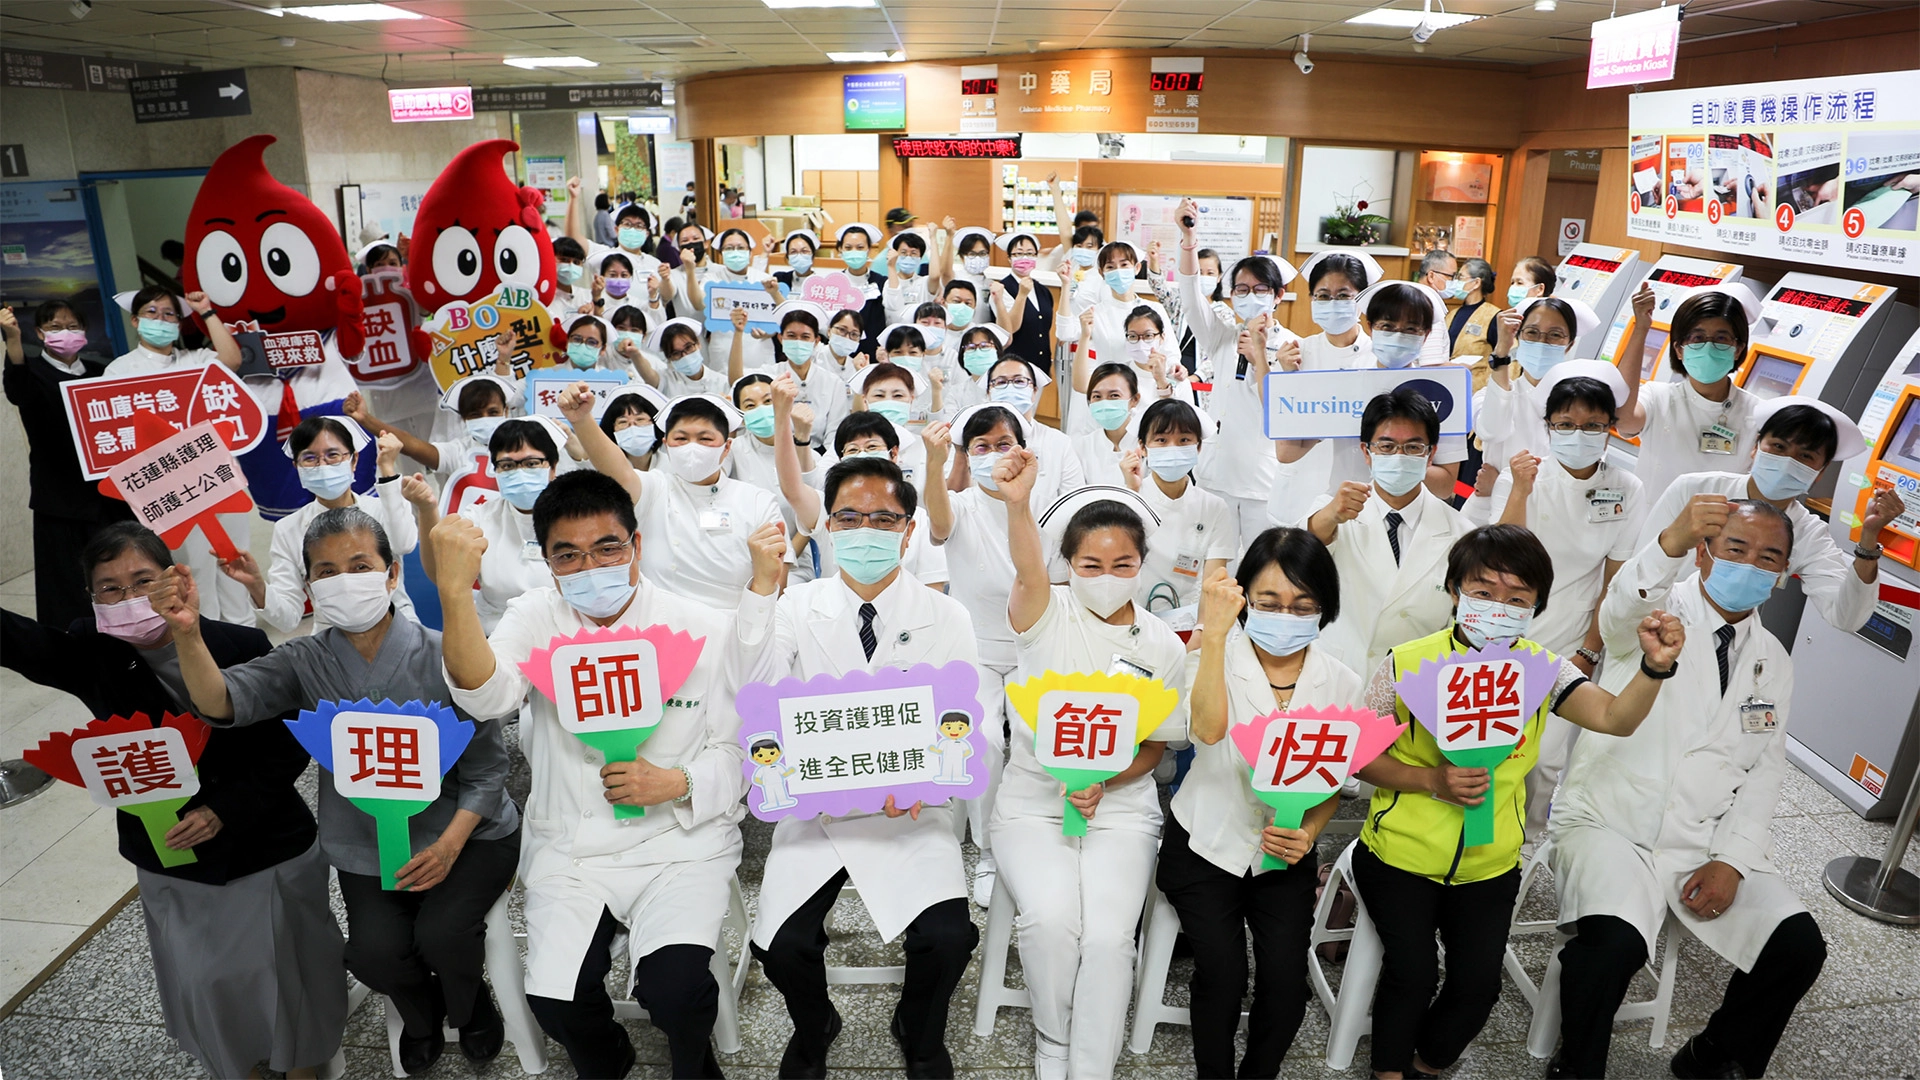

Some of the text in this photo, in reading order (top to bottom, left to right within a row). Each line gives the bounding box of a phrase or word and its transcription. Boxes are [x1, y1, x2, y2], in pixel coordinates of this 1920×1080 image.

[1643, 58, 1669, 71] Kiosk
[963, 79, 998, 95] 5014
[1019, 70, 1112, 95] 中藥局
[1150, 73, 1204, 91] 6001
[962, 98, 996, 111] 中藥
[1044, 104, 1073, 112] Medicine
[1075, 104, 1111, 114] Pharmacy
[1153, 94, 1199, 108] 草藥
[1691, 91, 1876, 125] 自助繳費機操作流程
[6, 147, 18, 174] 1
[1667, 198, 1675, 216] 2
[1710, 203, 1719, 221] 3
[1779, 208, 1789, 228] 4
[1847, 213, 1860, 234] 5
[811, 284, 840, 300] 快樂
[1857, 286, 1874, 299] 4
[432, 287, 532, 356] A B O AB
[263, 334, 316, 349] 血液庫存
[266, 346, 323, 367] 我來救
[1279, 396, 1364, 418] Nursing
[121, 432, 218, 493] 花蓮縣護理
[142, 462, 236, 523] 師護士公會
[1898, 476, 1907, 487] 2
[1907, 479, 1916, 490] 6
[570, 654, 643, 722] 師
[1446, 662, 1520, 743] 樂
[794, 702, 922, 735] 投資護理促
[1053, 702, 1123, 760] 節
[347, 726, 424, 790] 理
[799, 747, 925, 782] 進全民健康
[1268, 721, 1348, 788] 快
[91, 740, 183, 798] 護
